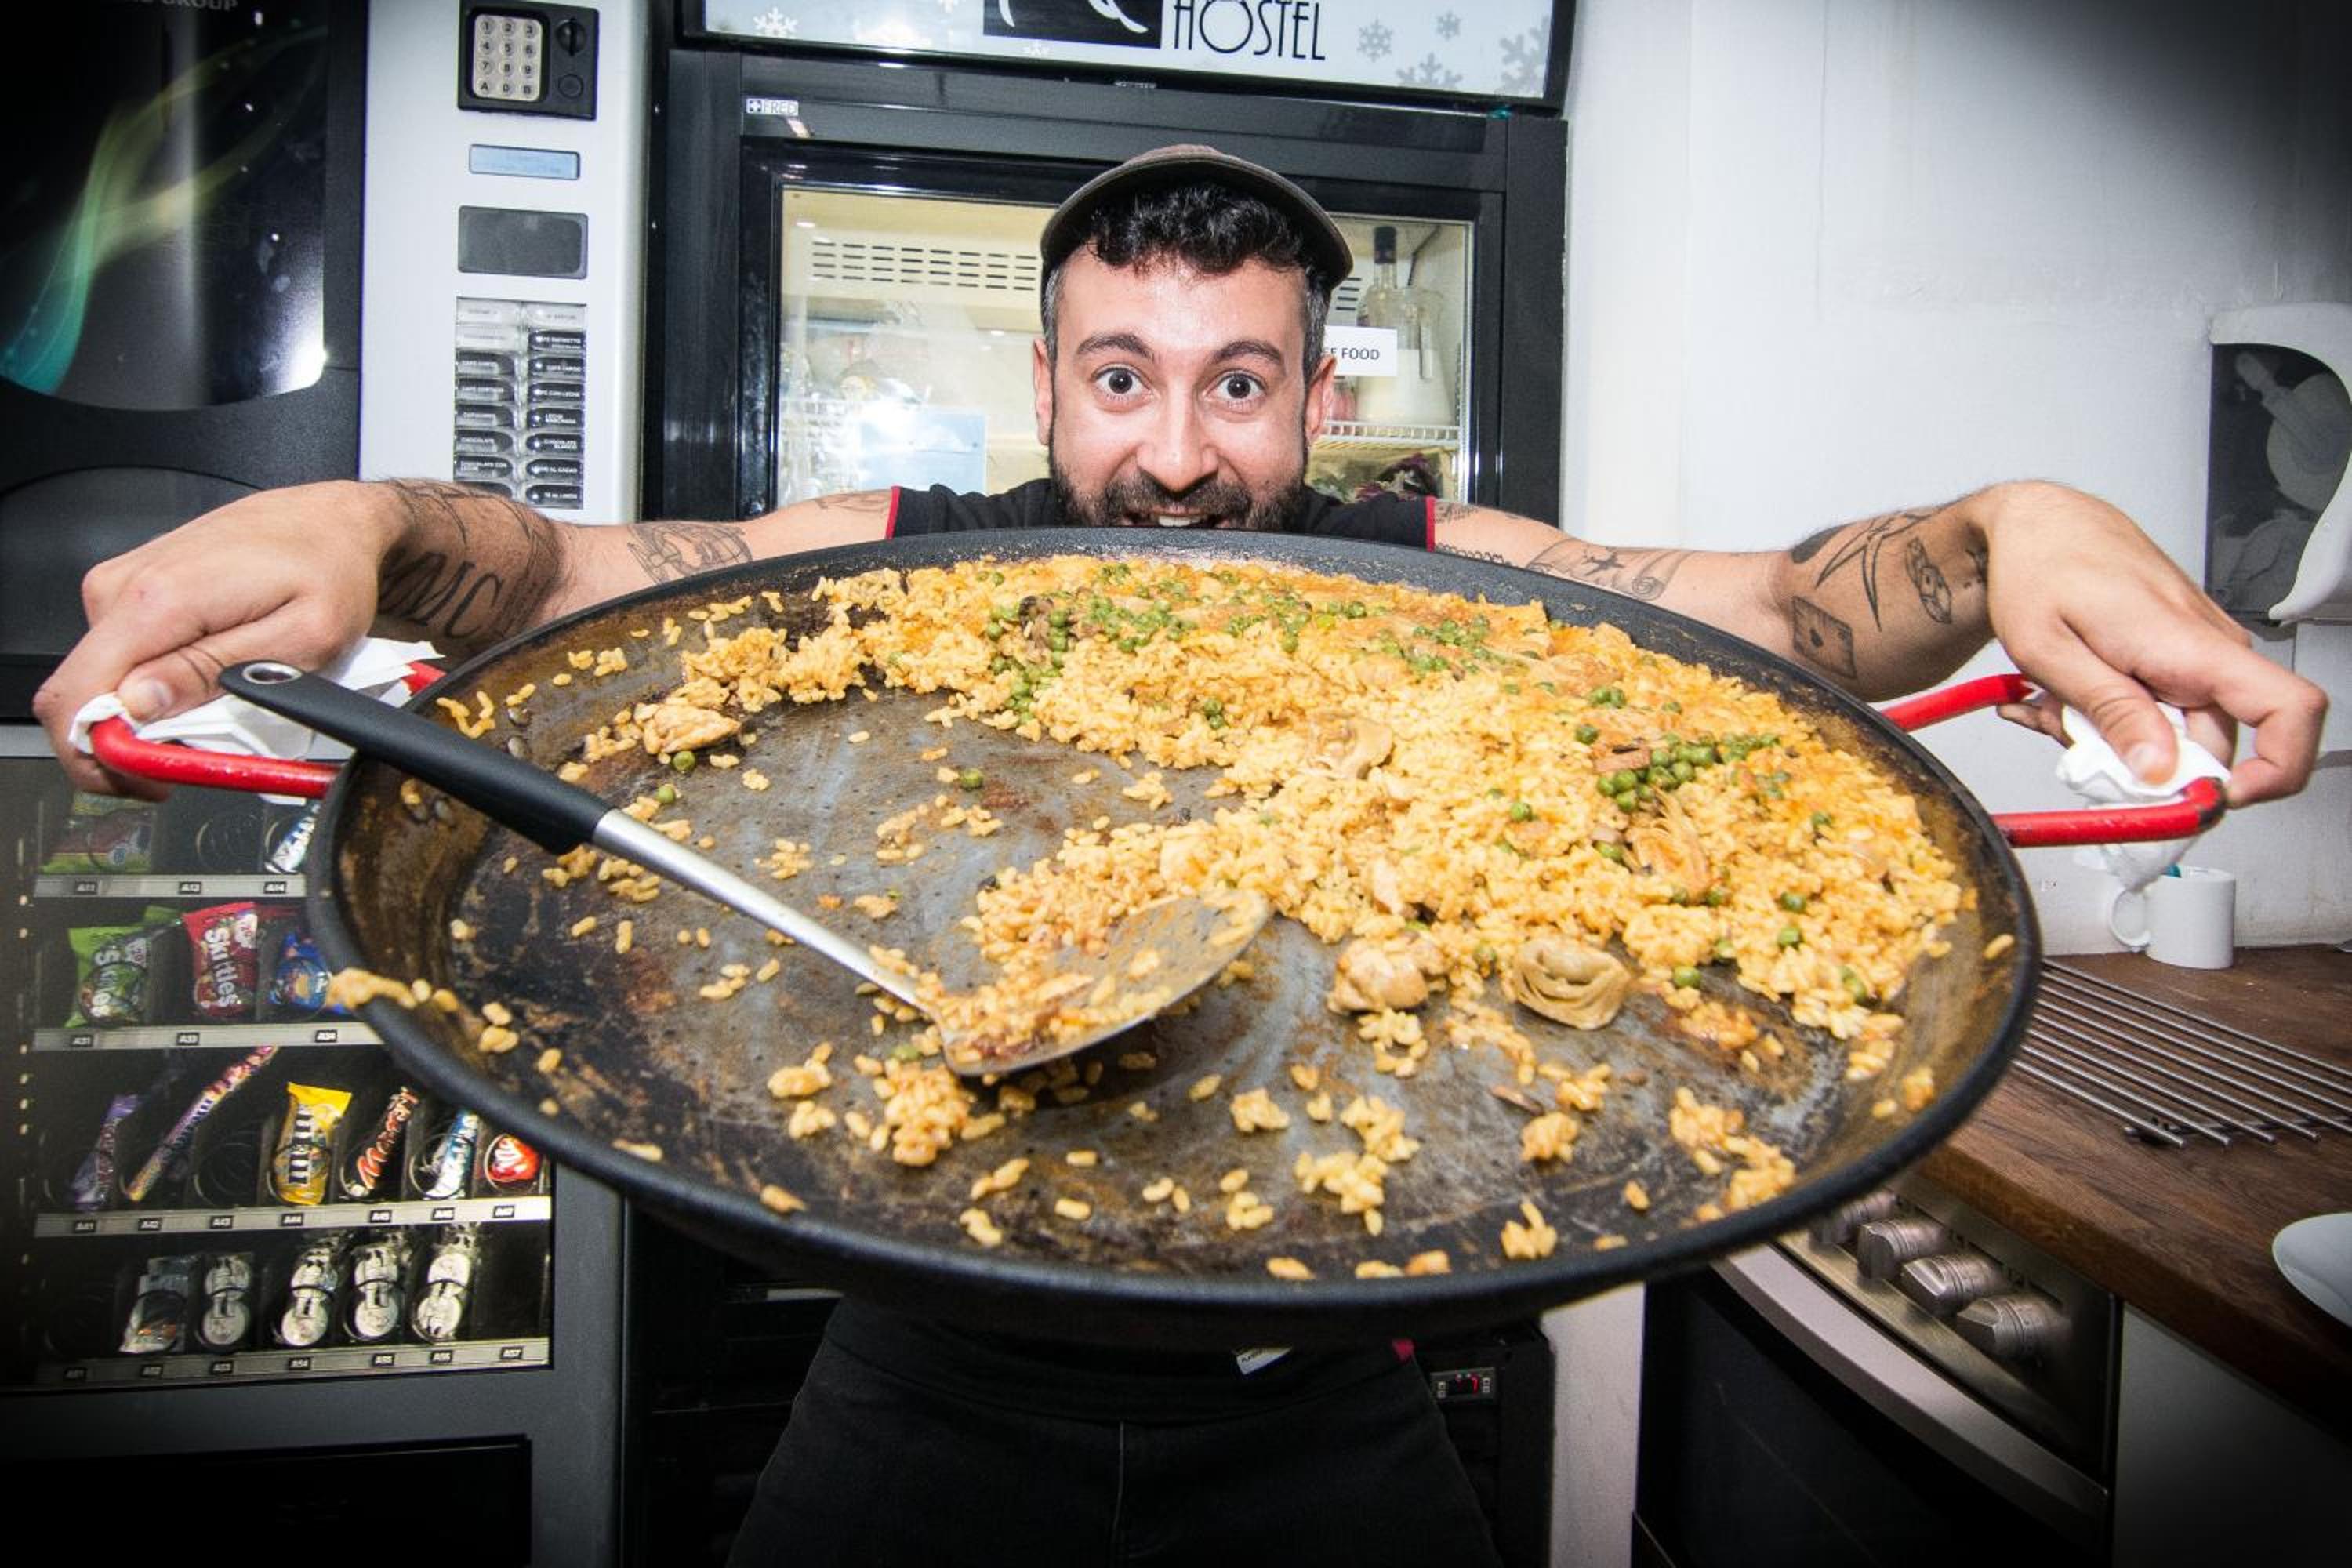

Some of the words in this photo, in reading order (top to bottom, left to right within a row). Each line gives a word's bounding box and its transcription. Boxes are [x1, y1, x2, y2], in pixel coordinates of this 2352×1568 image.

[1174, 0, 1326, 60] HOSTEL
[1341, 347, 1381, 360] FOOD
[205, 927, 239, 1008] Skittles
